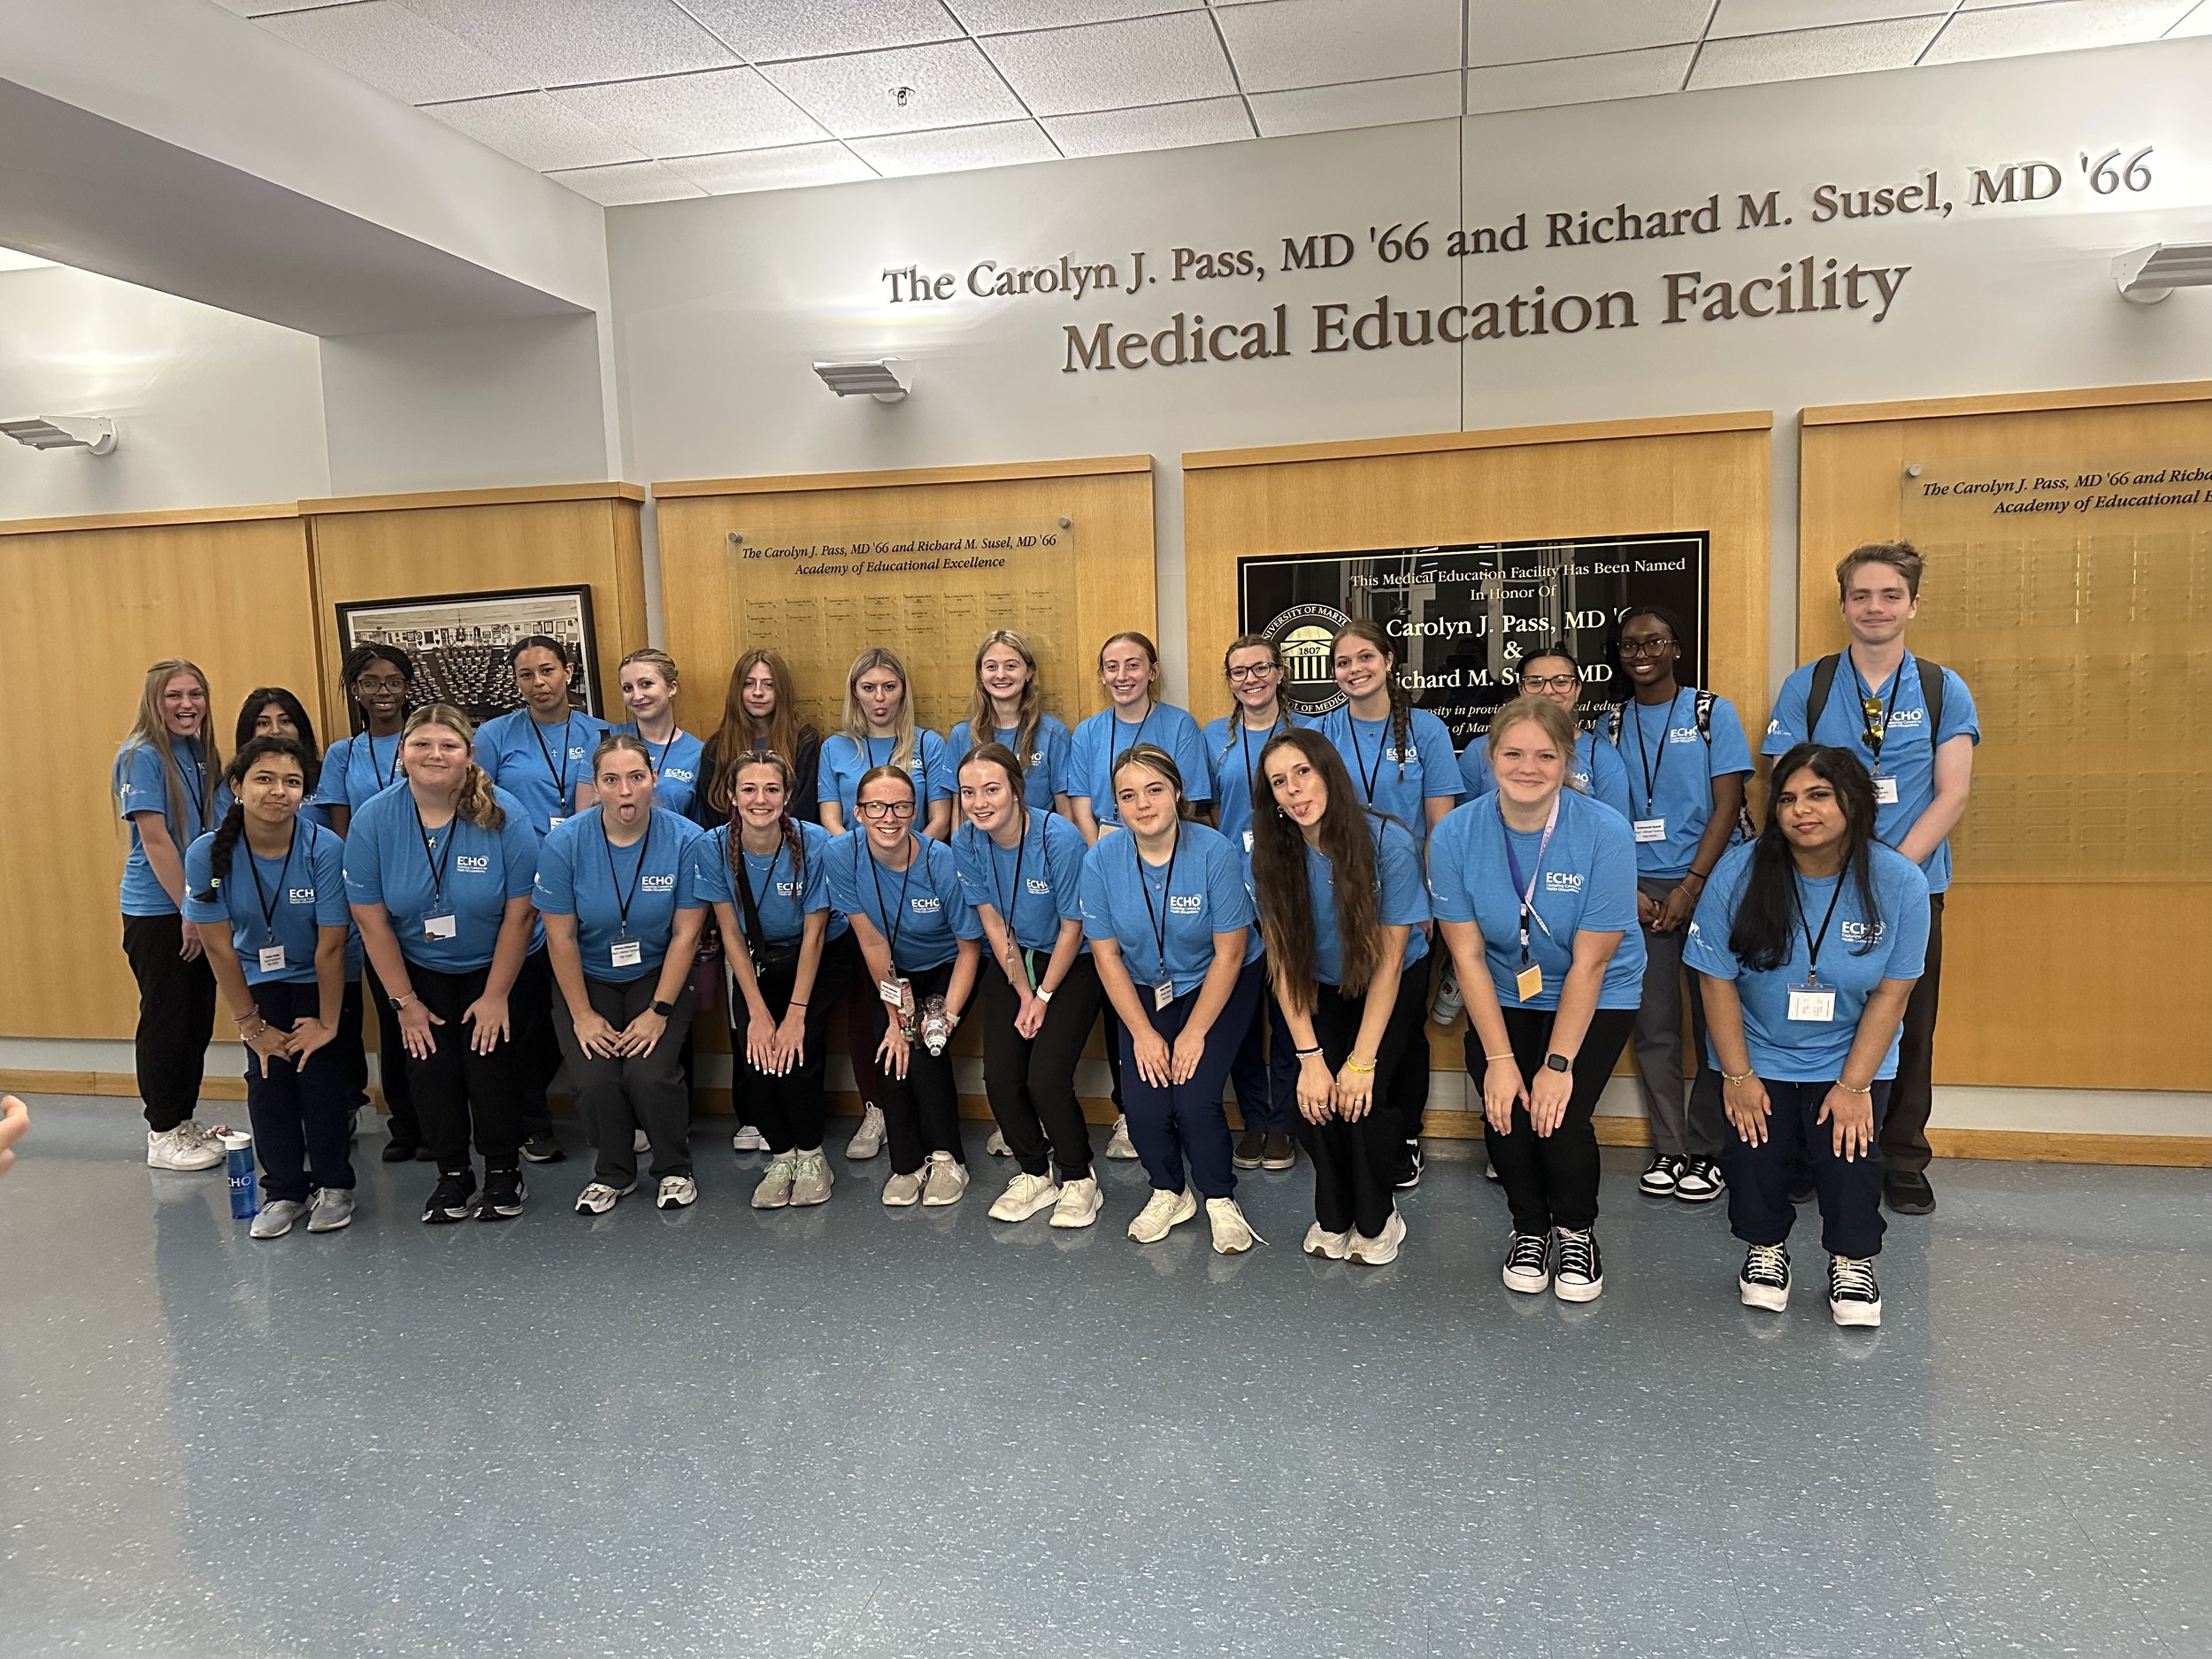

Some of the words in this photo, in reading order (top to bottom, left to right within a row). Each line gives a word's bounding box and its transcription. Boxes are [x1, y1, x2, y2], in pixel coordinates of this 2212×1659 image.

[883, 265, 956, 303] The
[967, 257, 1118, 301] Carolyn
[1125, 252, 1156, 295] J.
[1171, 247, 1265, 282] Pass,
[1280, 234, 1355, 272] MD
[1371, 221, 1430, 264] '66
[1447, 214, 1528, 257] and
[1546, 195, 1720, 249] Richard
[1736, 191, 1793, 231] M.
[1811, 171, 1952, 224] Susel,
[1972, 164, 2062, 208] MD
[2079, 145, 2154, 194] '66
[1061, 304, 1291, 373] Medical
[1311, 285, 1639, 354] Education
[1662, 256, 1913, 324] Facility
[1924, 483, 1949, 495] The
[1953, 479, 2014, 495] Carolyn
[2016, 478, 2028, 494] J.
[2032, 477, 2070, 491] Pass,
[2075, 474, 2102, 488] MD
[2107, 471, 2131, 486] '66
[2132, 470, 2167, 485] and
[2169, 467, 2212, 483] Richa
[1993, 498, 2070, 513] Academy
[2074, 495, 2094, 512] of
[2094, 489, 2201, 509] Educational
[742, 547, 762, 559] The
[764, 545, 808, 560] Carolyn
[809, 545, 818, 558] J.
[821, 545, 848, 557] Pass,
[850, 543, 871, 555] MD
[872, 541, 890, 554] '66
[892, 541, 915, 553] and
[917, 539, 963, 552] Richard
[964, 539, 979, 549] M.
[981, 536, 1014, 550] Susel,
[1017, 535, 1037, 548] MD
[1040, 534, 1057, 546] '66
[795, 563, 849, 577] Academy
[851, 561, 865, 576] of
[866, 558, 941, 572] Educational
[943, 557, 1006, 569] Excellence
[1351, 574, 1379, 587] This
[1382, 572, 1434, 586] Medical
[1437, 568, 1506, 583] Education
[1511, 565, 1560, 580] Facility
[1563, 563, 1590, 576] Has
[1594, 562, 1631, 574] Been
[1634, 557, 1686, 572] Named
[1470, 588, 1486, 601] In
[1489, 586, 1535, 600] Honor
[1538, 584, 1557, 598] Of
[1263, 607, 1302, 640] NIVERSITY
[1317, 606, 1348, 626] MARYL
[1386, 616, 1472, 640] Carolyn
[1476, 615, 1494, 638] J.
[1502, 614, 1556, 634] Pass,
[1563, 610, 1606, 630] MD
[1502, 641, 1524, 660] &
[1394, 668, 1462, 689] ichard
[1467, 669, 1494, 687] M.
[1577, 664, 1613, 682] MD
[1454, 705, 1466, 715] in
[1452, 723, 1465, 735] of
[664, 767, 694, 780] ECHO
[457, 856, 488, 867] ECHO
[641, 876, 673, 886] ECHO
[1546, 872, 1581, 887] ECHO
[289, 888, 314, 898] ECH
[1170, 895, 1201, 908] ECHO
[911, 897, 940, 908] ECHO
